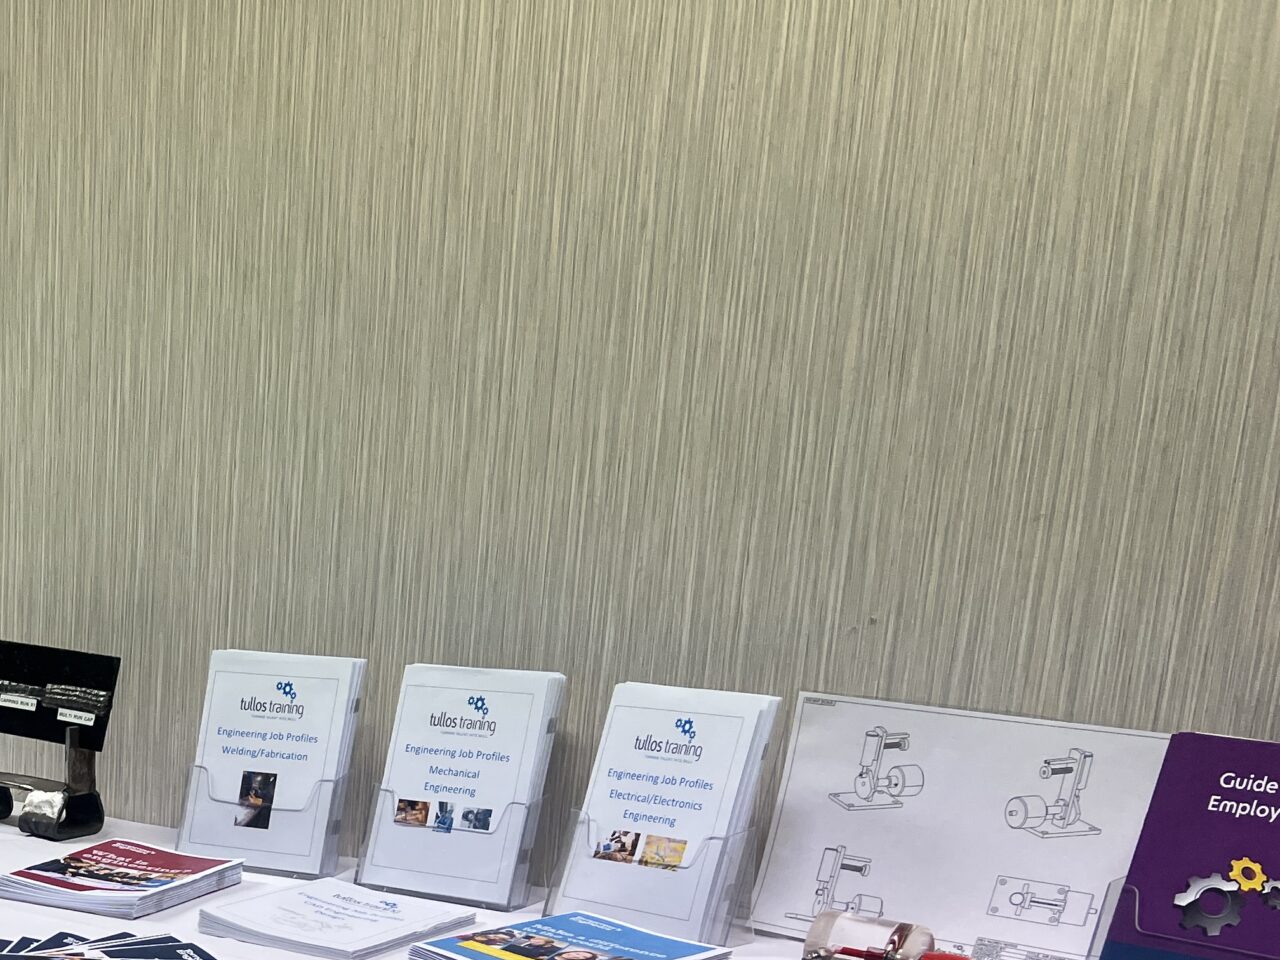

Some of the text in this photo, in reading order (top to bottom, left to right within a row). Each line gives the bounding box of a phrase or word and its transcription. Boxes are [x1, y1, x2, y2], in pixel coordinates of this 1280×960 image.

[240, 696, 304, 719] tullos training
[429, 712, 457, 728] tullos
[460, 716, 497, 736] training
[217, 727, 318, 743] Engineering Job Profiles
[222, 745, 308, 761] Welding/Fabrication
[405, 744, 510, 762] Engineering Job Profiles
[634, 734, 663, 752] tullos
[664, 739, 703, 761] training
[429, 765, 480, 779] Mechanical
[607, 768, 714, 790] Engineering Job Profiles
[424, 782, 476, 798] Engineering
[1220, 772, 1279, 794] Guide
[609, 789, 703, 811] Electrical/Electronics
[623, 809, 676, 828] Engineering
[92, 849, 132, 862] What
